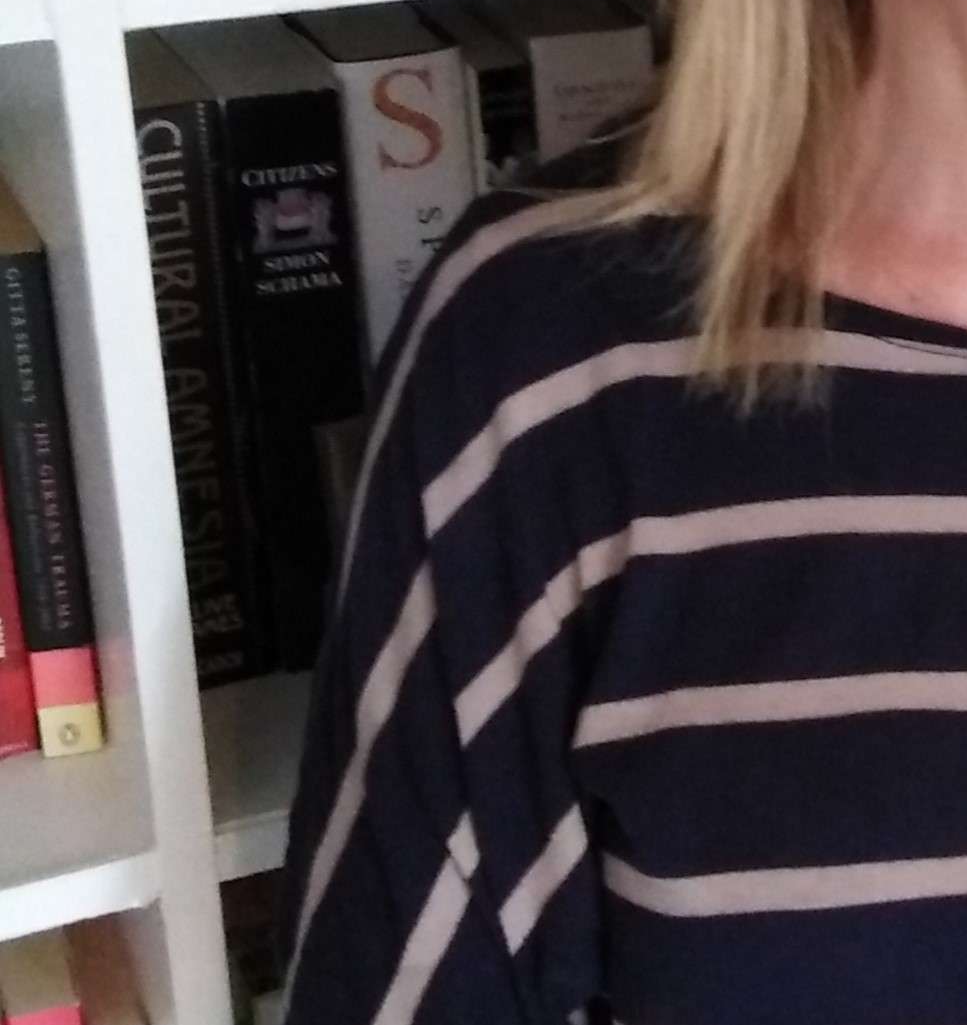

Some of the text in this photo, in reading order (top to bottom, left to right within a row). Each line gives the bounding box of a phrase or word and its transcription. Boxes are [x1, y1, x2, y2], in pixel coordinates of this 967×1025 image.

[373, 67, 444, 171] S
[240, 160, 338, 188] CITIZENS
[263, 251, 331, 272] SIMON
[255, 272, 343, 297] SCHAMA
[33, 422, 51, 454] THE
[40, 464, 62, 545] GERMAN
